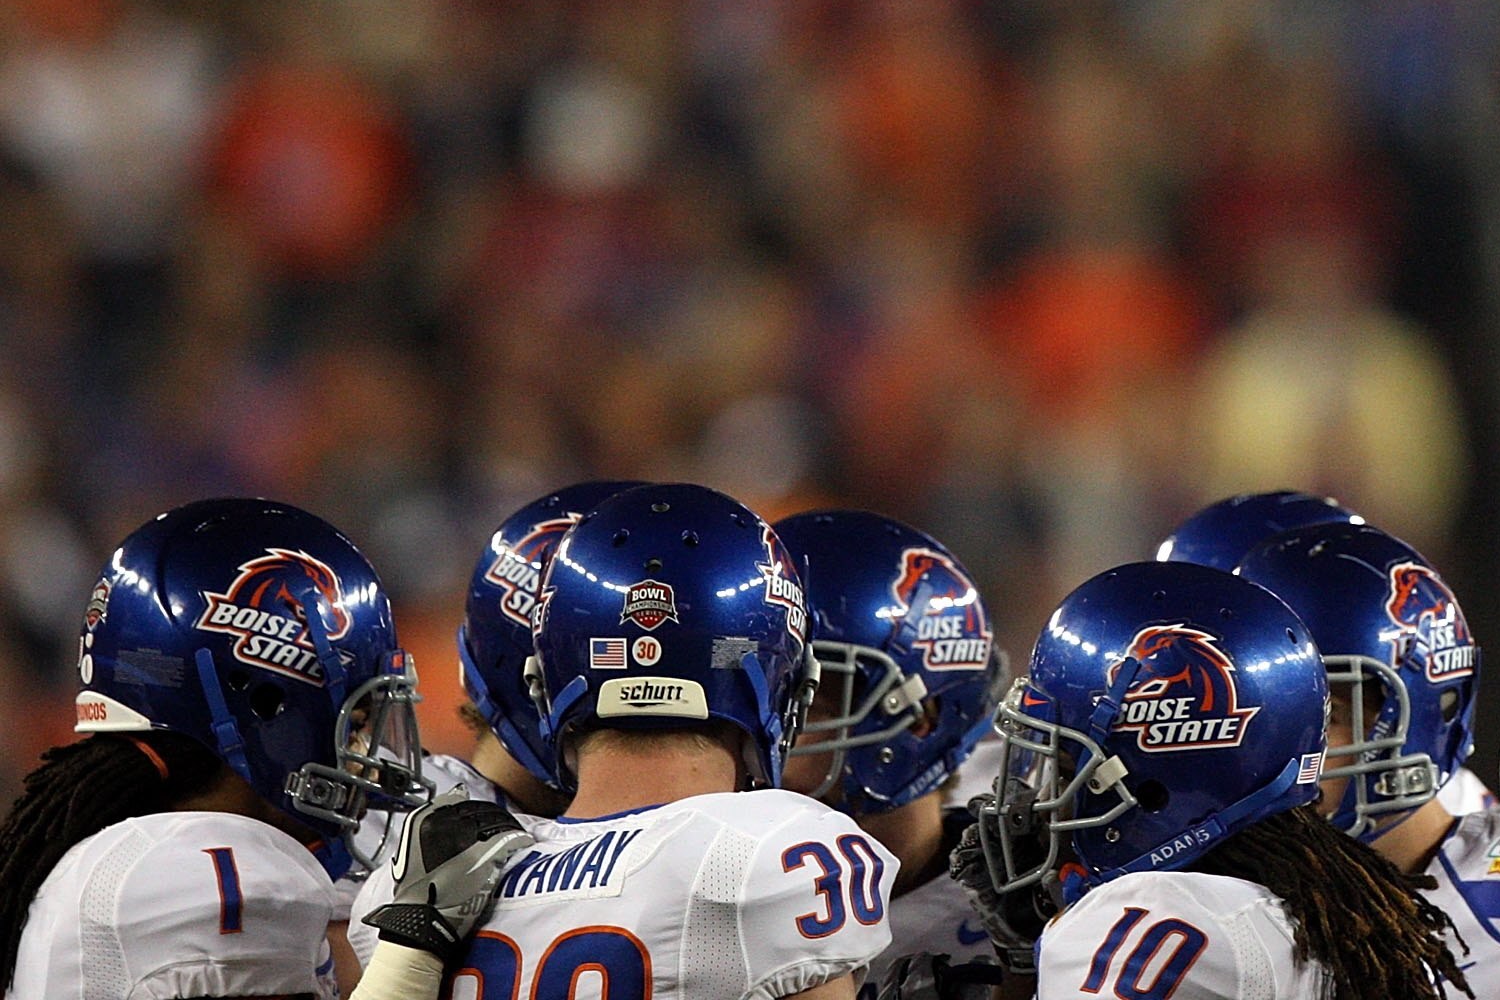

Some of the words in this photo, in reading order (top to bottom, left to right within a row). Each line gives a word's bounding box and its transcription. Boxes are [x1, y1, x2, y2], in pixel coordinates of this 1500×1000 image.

[494, 556, 540, 593] BOIS
[632, 588, 667, 601] BOWL
[210, 602, 303, 642] BOISE
[919, 616, 964, 640] OISE
[637, 642, 657, 660] 30
[931, 639, 986, 663] STATE
[1147, 717, 1240, 744] STATE
[200, 847, 244, 935] 1
[781, 833, 885, 939] 30
[1080, 907, 1209, 1000] 10
